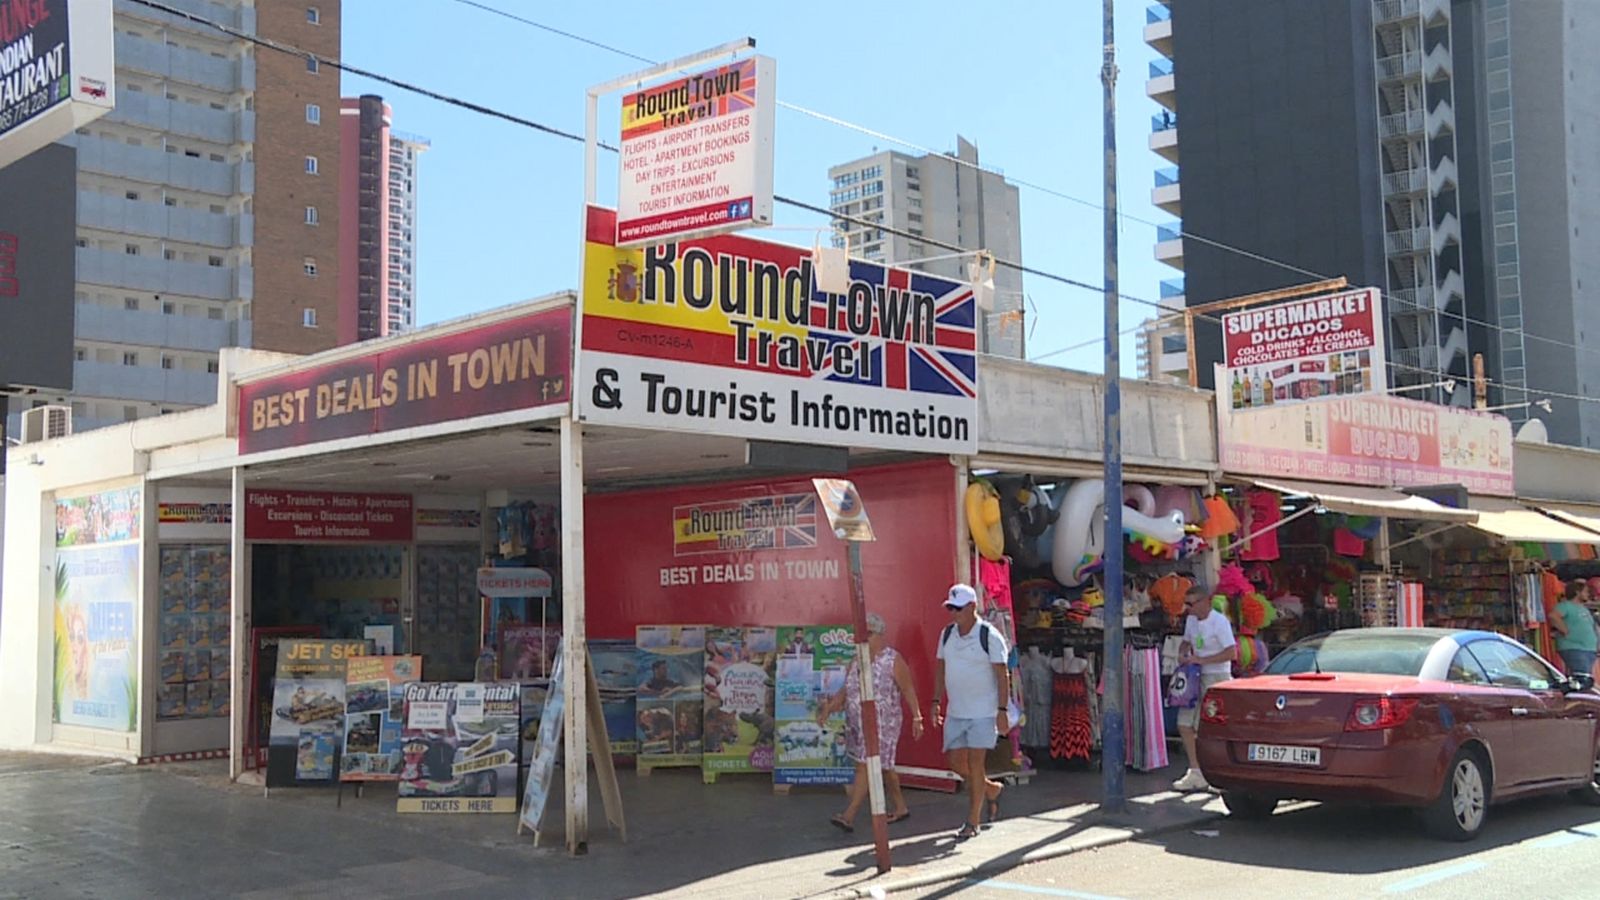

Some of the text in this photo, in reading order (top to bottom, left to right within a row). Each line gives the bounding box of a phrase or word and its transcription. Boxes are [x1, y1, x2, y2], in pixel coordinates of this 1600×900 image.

[636, 69, 740, 119] Round Town
[662, 102, 712, 128] Travel
[624, 115, 750, 156] FLIGHTS AIRPORT TRANSFERS
[623, 132, 750, 172] HOTEL APARTMENT BOOKINGS
[635, 151, 735, 184] DAY TRIPS EXCURSIONS
[650, 171, 717, 196] ENTERTAINMENT
[638, 185, 730, 214] TOURIST INFORMATION
[620, 210, 729, 238] www.roundtowntravel.com
[644, 244, 812, 325] Round
[1228, 294, 1367, 334] SUPERMARKET
[1237, 329, 1364, 356] COLD DRINKS ALCOHOL
[1251, 318, 1343, 345] DUCADOS
[729, 319, 870, 378] Travel
[1233, 336, 1370, 366] CHOCOLATES ICE CREAMS
[252, 335, 545, 431] BEST DEALS IN TOWN
[592, 368, 969, 441] & Tourist Information
[1330, 403, 1437, 435] SUPERMARKET
[1351, 427, 1420, 462] DUCADO
[250, 494, 278, 507] Flights
[287, 495, 325, 506] Transfers
[365, 497, 409, 508] Apartments
[267, 509, 393, 522] Excursions Discounted Tickets
[689, 503, 796, 535] Round Town
[294, 525, 370, 536] Tourist Information
[718, 528, 770, 550] Travel
[660, 560, 839, 586] BEST DEALS IN TOWN
[287, 643, 366, 659] JET SKI
[407, 684, 426, 700] Go
[1258, 746, 1317, 762] 9167 LBW
[422, 801, 493, 810] TICKETS HERE
